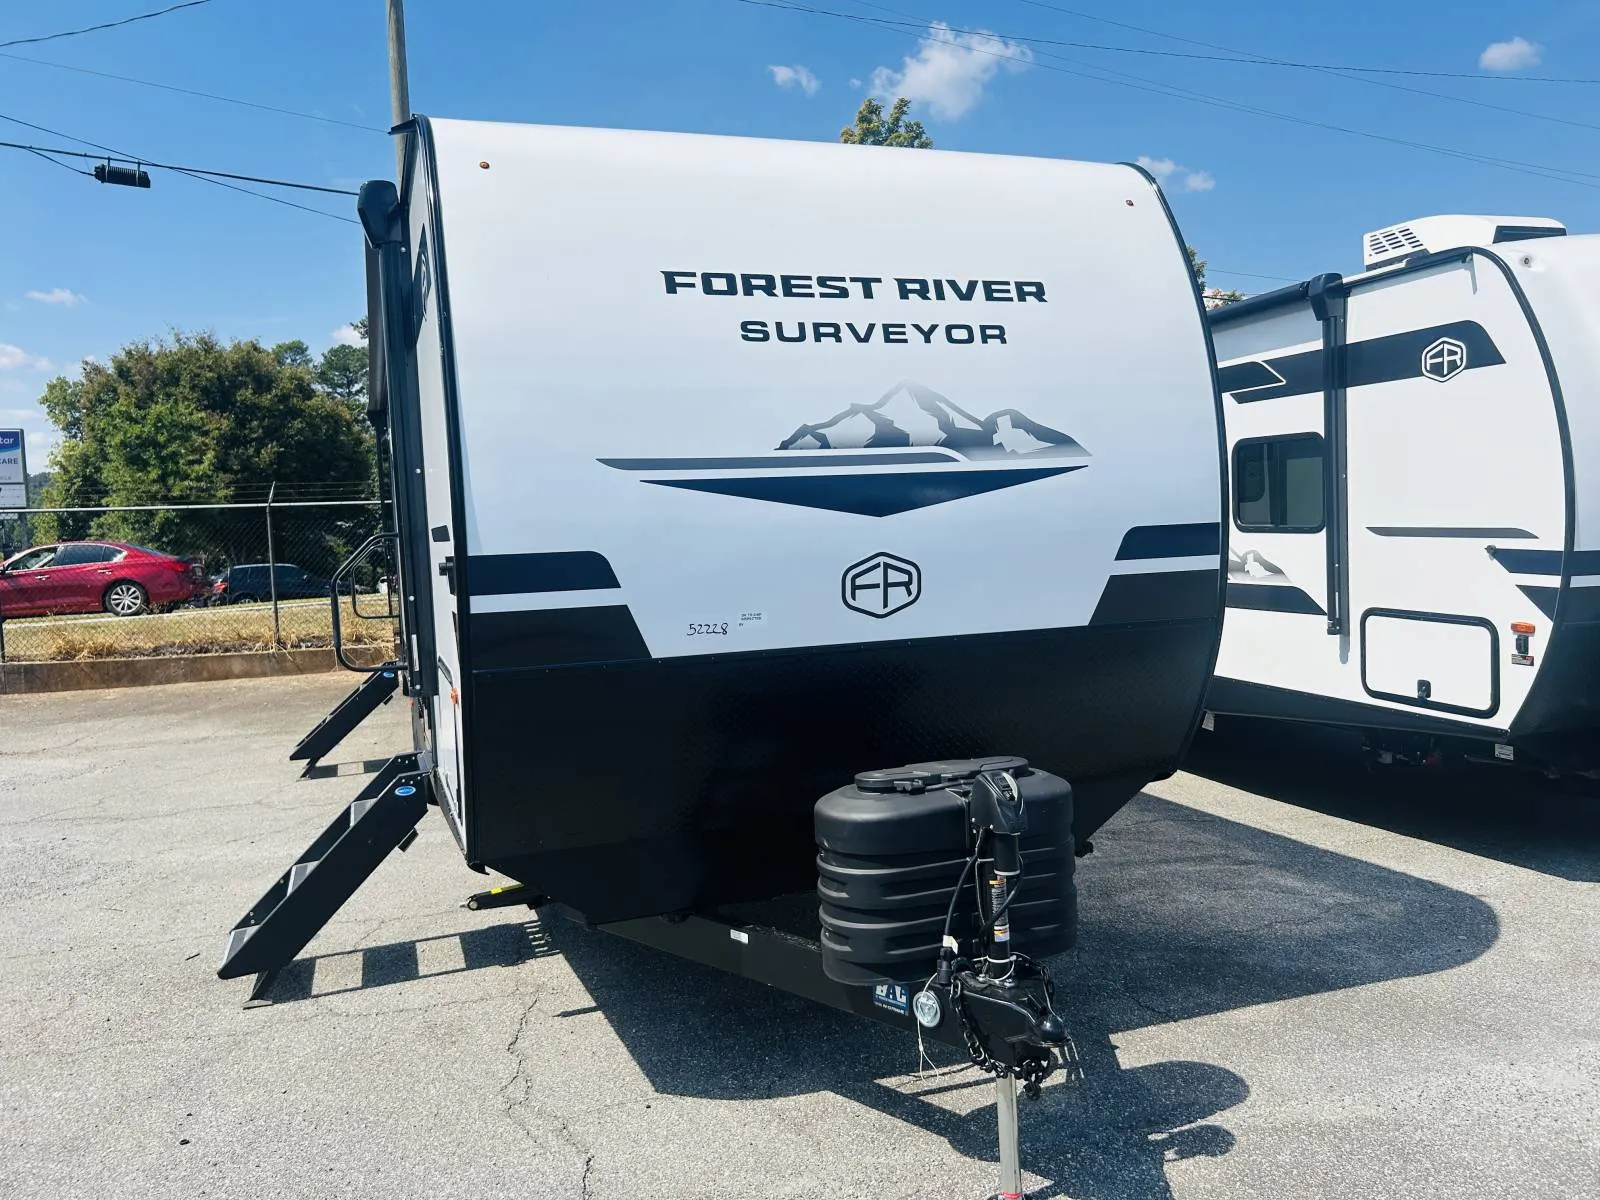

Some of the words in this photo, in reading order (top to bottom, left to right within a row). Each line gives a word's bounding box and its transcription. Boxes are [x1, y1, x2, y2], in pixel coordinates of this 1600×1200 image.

[659, 270, 883, 300] FOREST
[892, 277, 1049, 303] RIVER
[740, 319, 1008, 345] SURVEYOR
[0, 457, 19, 465] ARE
[686, 622, 729, 636] 52228
